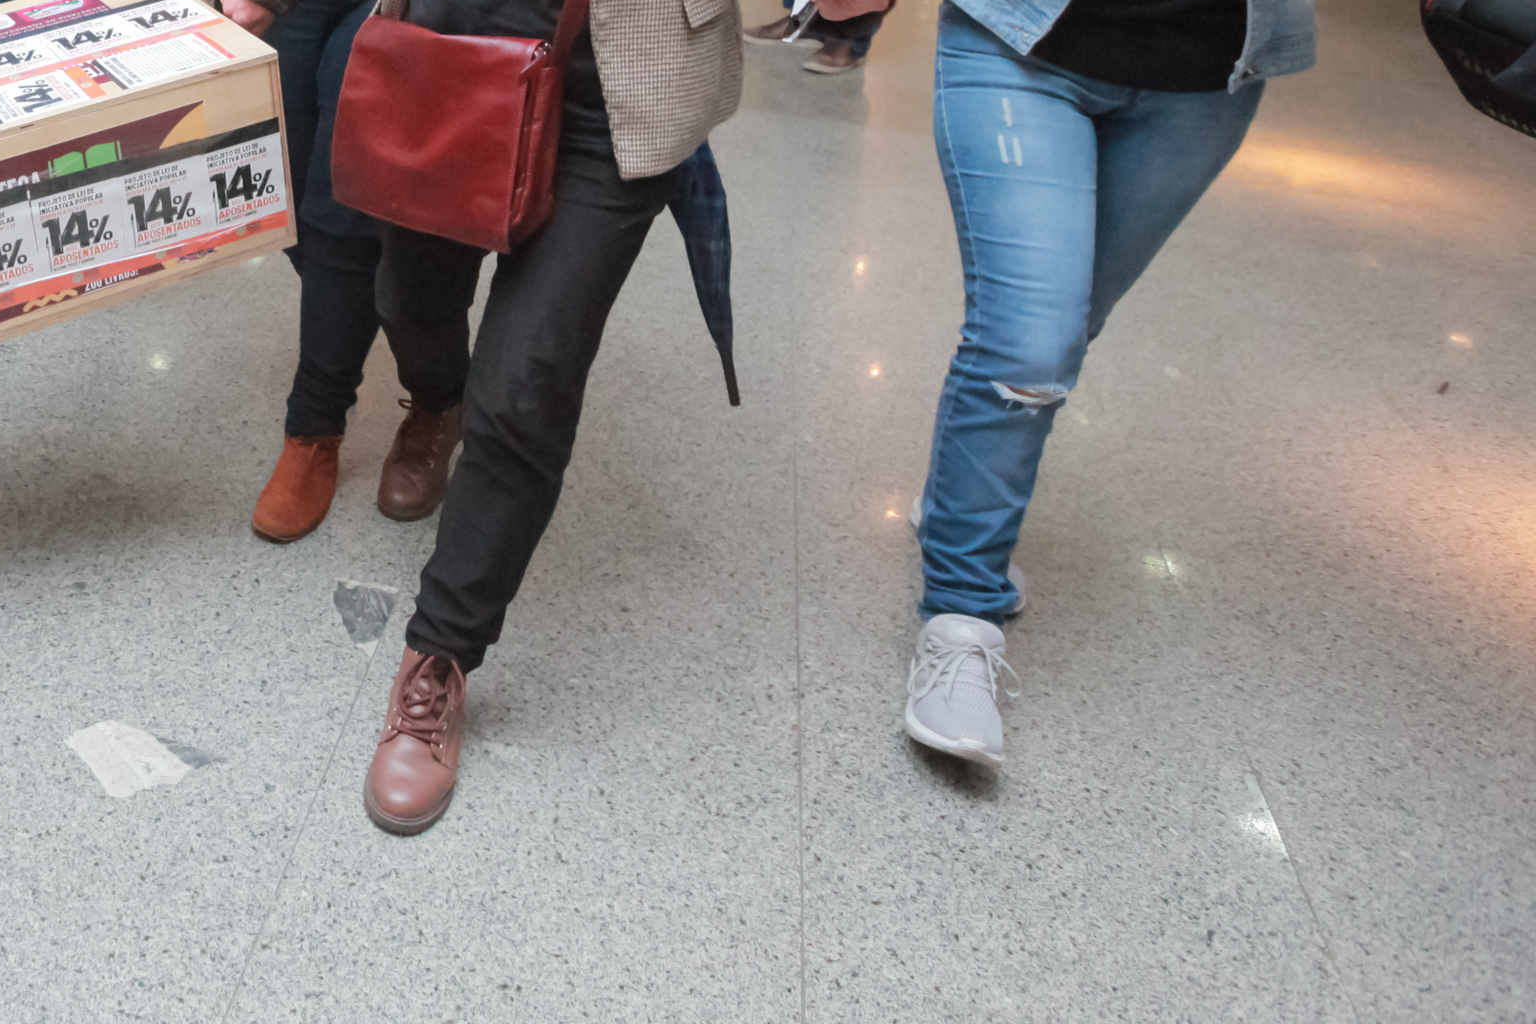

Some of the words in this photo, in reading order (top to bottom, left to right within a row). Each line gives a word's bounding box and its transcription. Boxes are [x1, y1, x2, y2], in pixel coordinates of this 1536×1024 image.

[127, 8, 198, 29] 14%
[51, 28, 122, 50] 14%
[14, 80, 63, 113] 14%
[207, 150, 232, 163] PROJETO
[208, 155, 239, 169] INICIATIVA
[240, 147, 266, 159] POPULAR
[124, 172, 150, 185] PROJETO
[125, 178, 158, 191] INICIATIVA
[159, 170, 186, 182] POPULAR
[209, 164, 275, 209] 14%
[38, 195, 65, 208] PROJETO
[39, 201, 73, 215] INICIATIVA
[75, 193, 103, 205] POPULAR
[127, 187, 195, 232] 14%
[220, 194, 280, 219] APOSENTADOS
[41, 210, 113, 256] 14%
[138, 217, 201, 242] APOSENTADOS
[54, 240, 119, 266] APOSENTADOS
